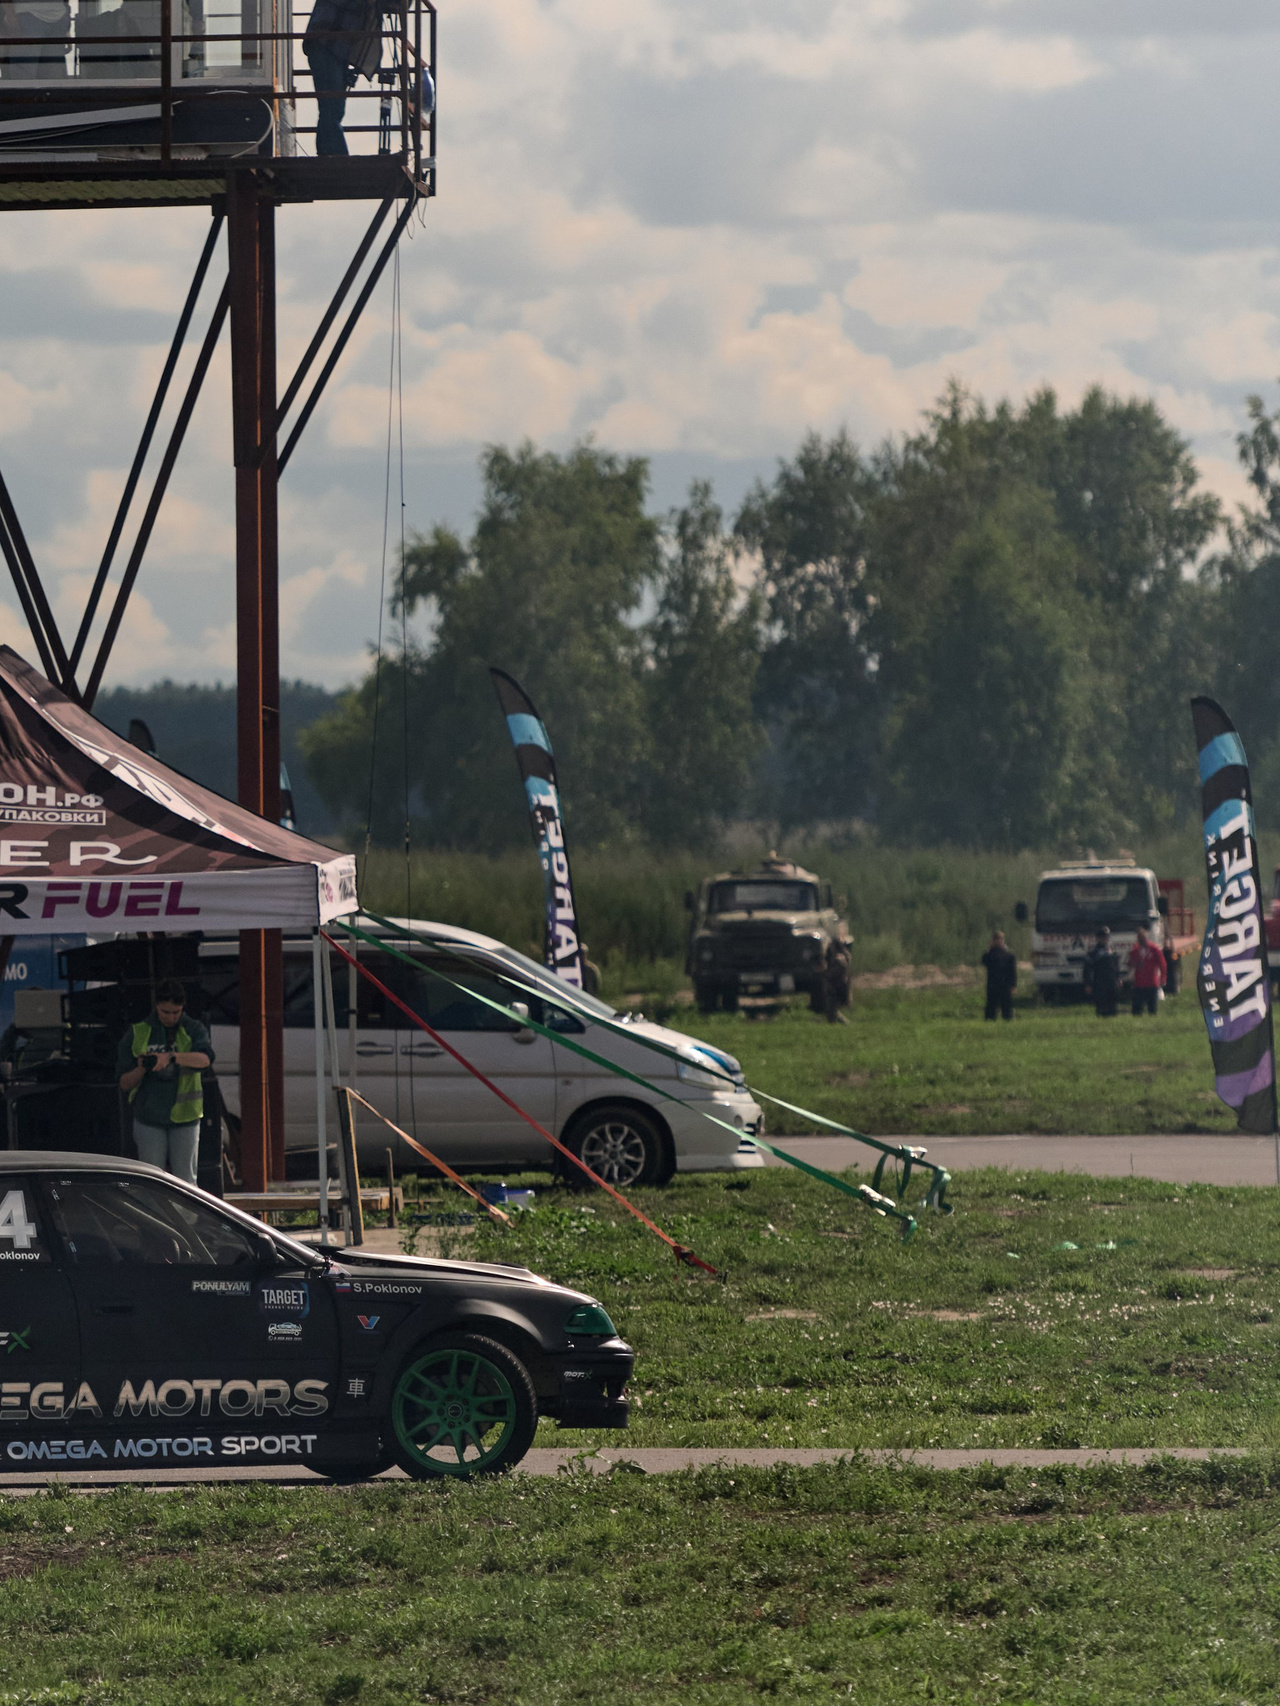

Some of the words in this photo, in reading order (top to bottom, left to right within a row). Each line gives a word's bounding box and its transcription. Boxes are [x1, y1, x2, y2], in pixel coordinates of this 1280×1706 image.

[41, 880, 201, 919] FUEL
[261, 1289, 305, 1305] TARGET
[353, 1282, 423, 1294] S.Poklonov
[113, 1379, 329, 1417] MOTORS
[6, 1440, 108, 1460] OMEGA
[113, 1437, 213, 1457] MOTOR
[221, 1435, 318, 1455] SPORT
